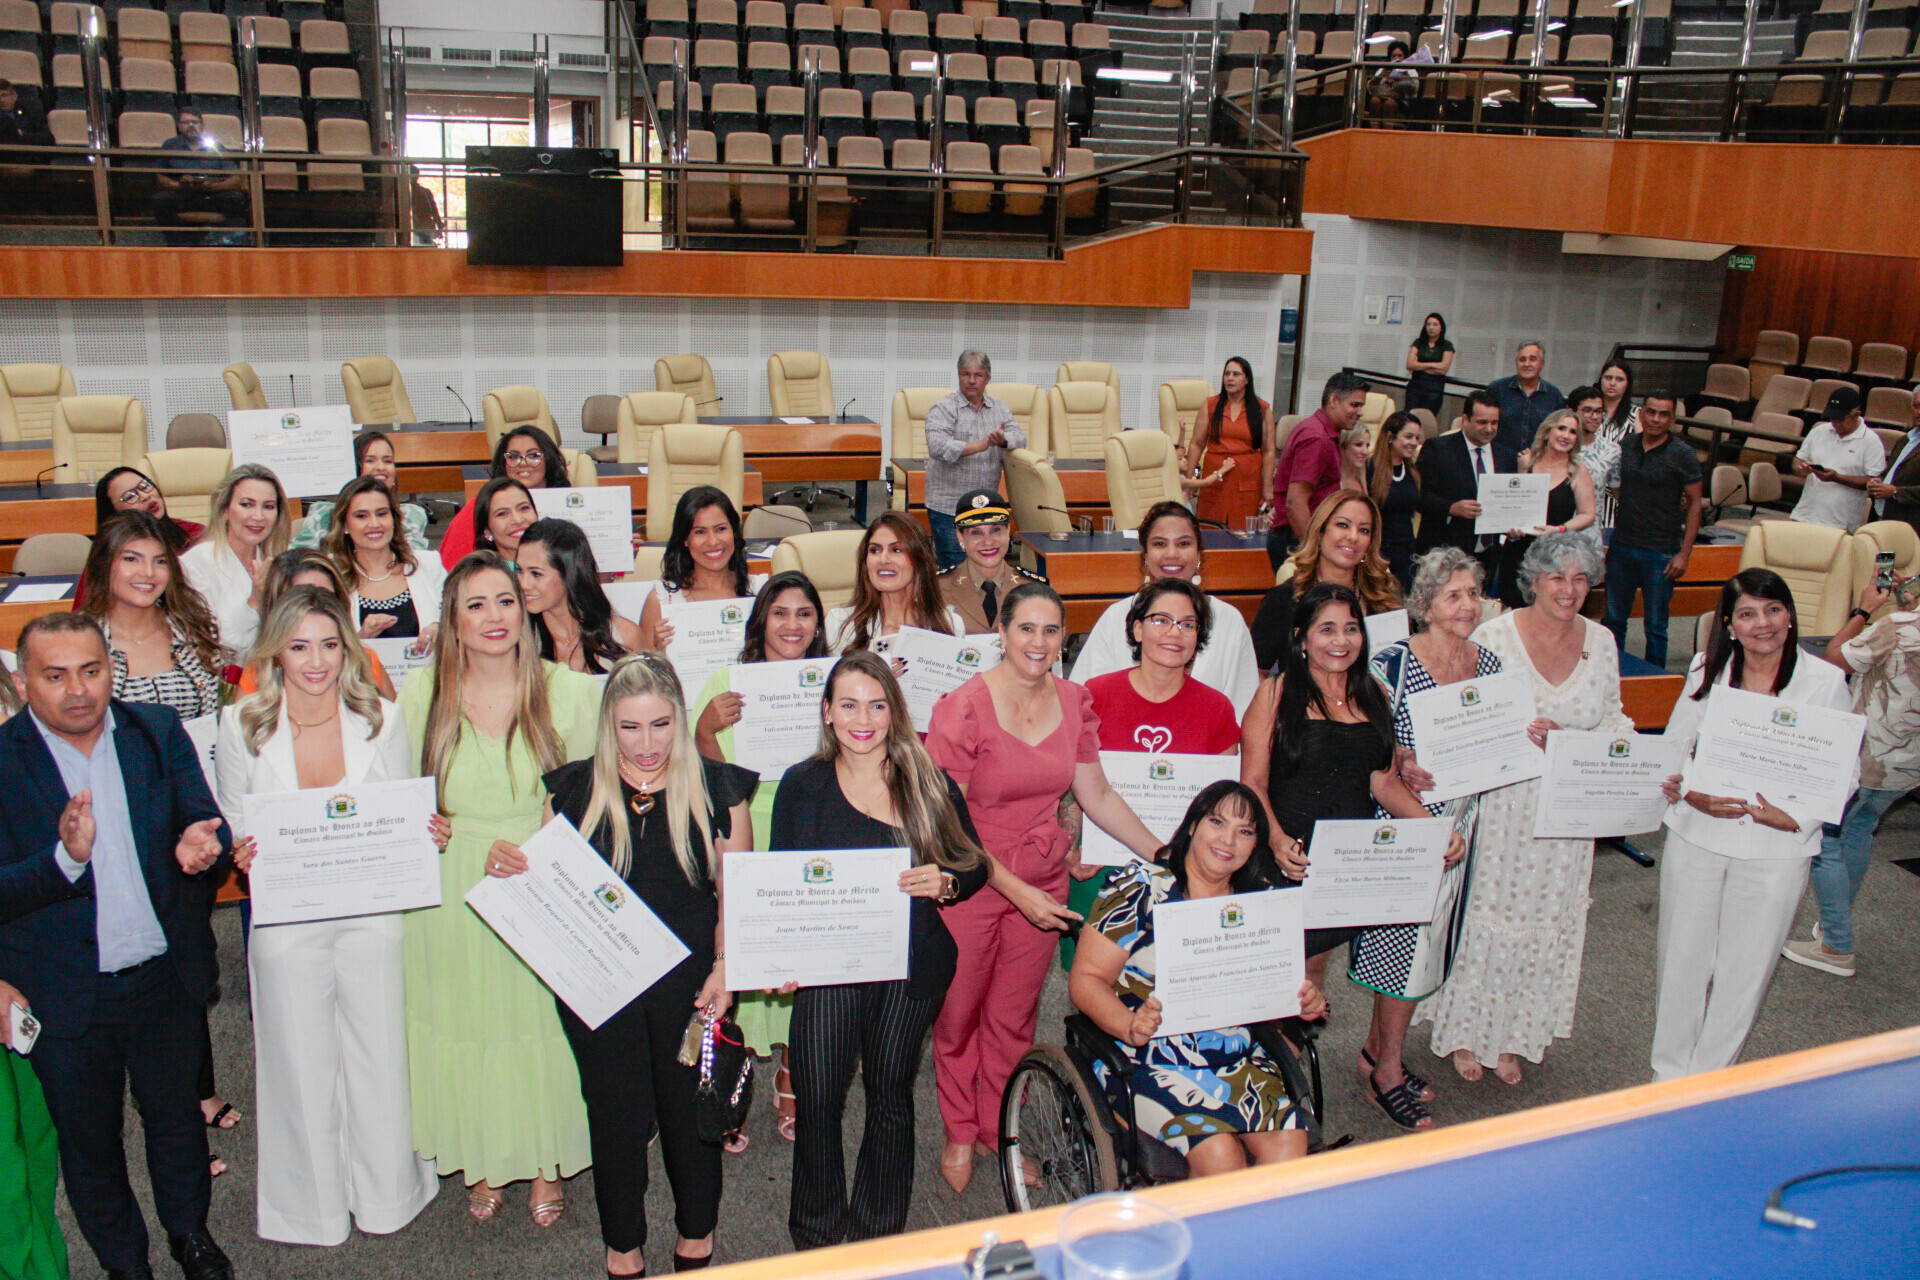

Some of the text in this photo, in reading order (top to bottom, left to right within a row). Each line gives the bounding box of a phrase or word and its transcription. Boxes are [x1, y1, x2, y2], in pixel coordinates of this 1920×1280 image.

[688, 630, 715, 638] Diploma
[917, 657, 944, 668] Diploma
[759, 694, 791, 702] Diploma
[1433, 715, 1457, 725] Diploma
[1640, 761, 1662, 769] Mérito
[1110, 782, 1140, 790] Diploma
[1152, 783, 1176, 791] Honra
[279, 826, 317, 836] Diploma
[333, 822, 361, 831] Honra
[376, 817, 405, 827] Mérito
[294, 836, 320, 844] Câmara
[322, 832, 356, 841] Municipal
[367, 828, 392, 837] Goiânia
[335, 858, 359, 866] Santos
[757, 888, 792, 898] Diploma
[808, 888, 835, 896] Honra
[851, 885, 880, 896] Mérito
[551, 860, 640, 956] Diploma de Honra ao Mérito
[770, 899, 795, 907] Câmara
[554, 878, 623, 951] Câmara Municipal de Goiânia
[563, 920, 571, 930] de
[569, 929, 588, 949] Castro
[776, 926, 796, 934] Jeane
[1182, 937, 1212, 947] Diploma
[1224, 932, 1246, 941] Honra
[1258, 927, 1281, 937] Mérito
[1279, 961, 1292, 969] Silva
